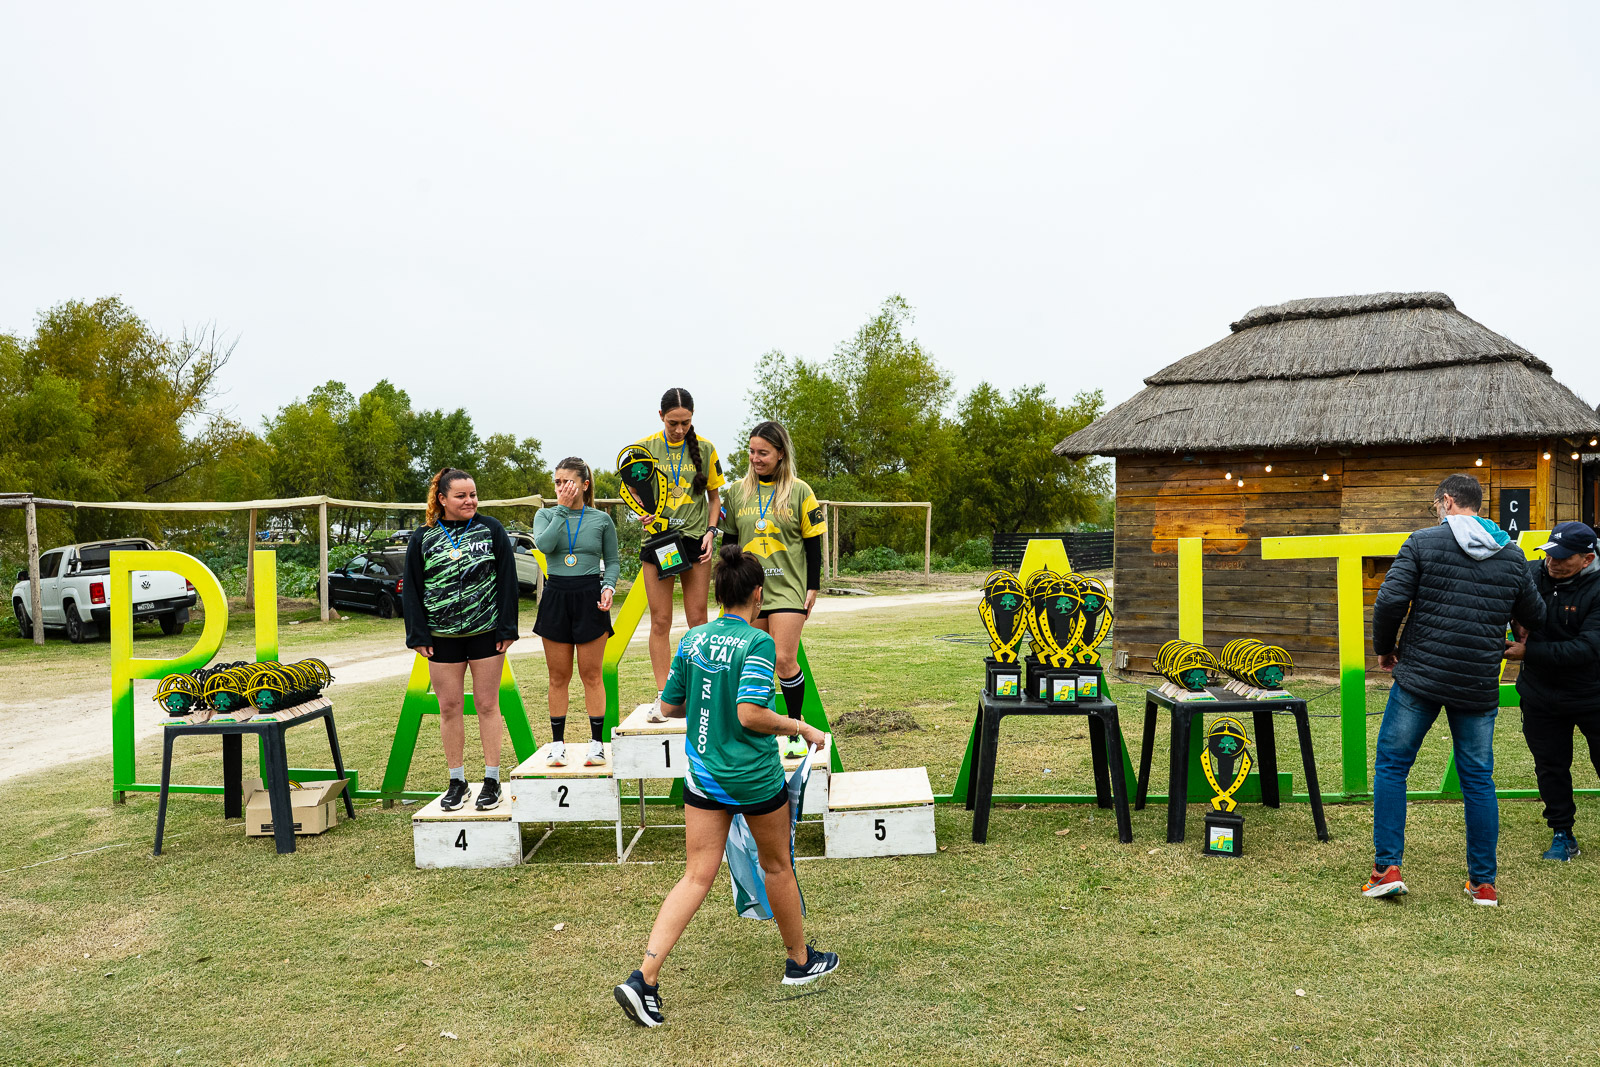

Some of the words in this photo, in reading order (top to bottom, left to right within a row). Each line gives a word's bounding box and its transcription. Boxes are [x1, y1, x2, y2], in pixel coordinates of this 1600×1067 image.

[666, 452, 685, 461] 216
[657, 463, 697, 472] NIVERSARI
[737, 506, 794, 518] ANIVESO
[1508, 500, 1519, 543] CA
[468, 542, 490, 552] VRT
[664, 552, 674, 566] 1
[710, 634, 748, 649] CORRE
[709, 645, 736, 664] TAI
[701, 677, 712, 700] TAI
[1002, 680, 1013, 695] 3
[1060, 685, 1070, 700] 3
[1082, 682, 1092, 695] 2
[697, 707, 710, 754] CORRE
[661, 739, 671, 768] 1
[557, 785, 570, 808] 2
[874, 818, 887, 841] 5
[454, 829, 468, 851] 4
[1217, 835, 1225, 849] 1
